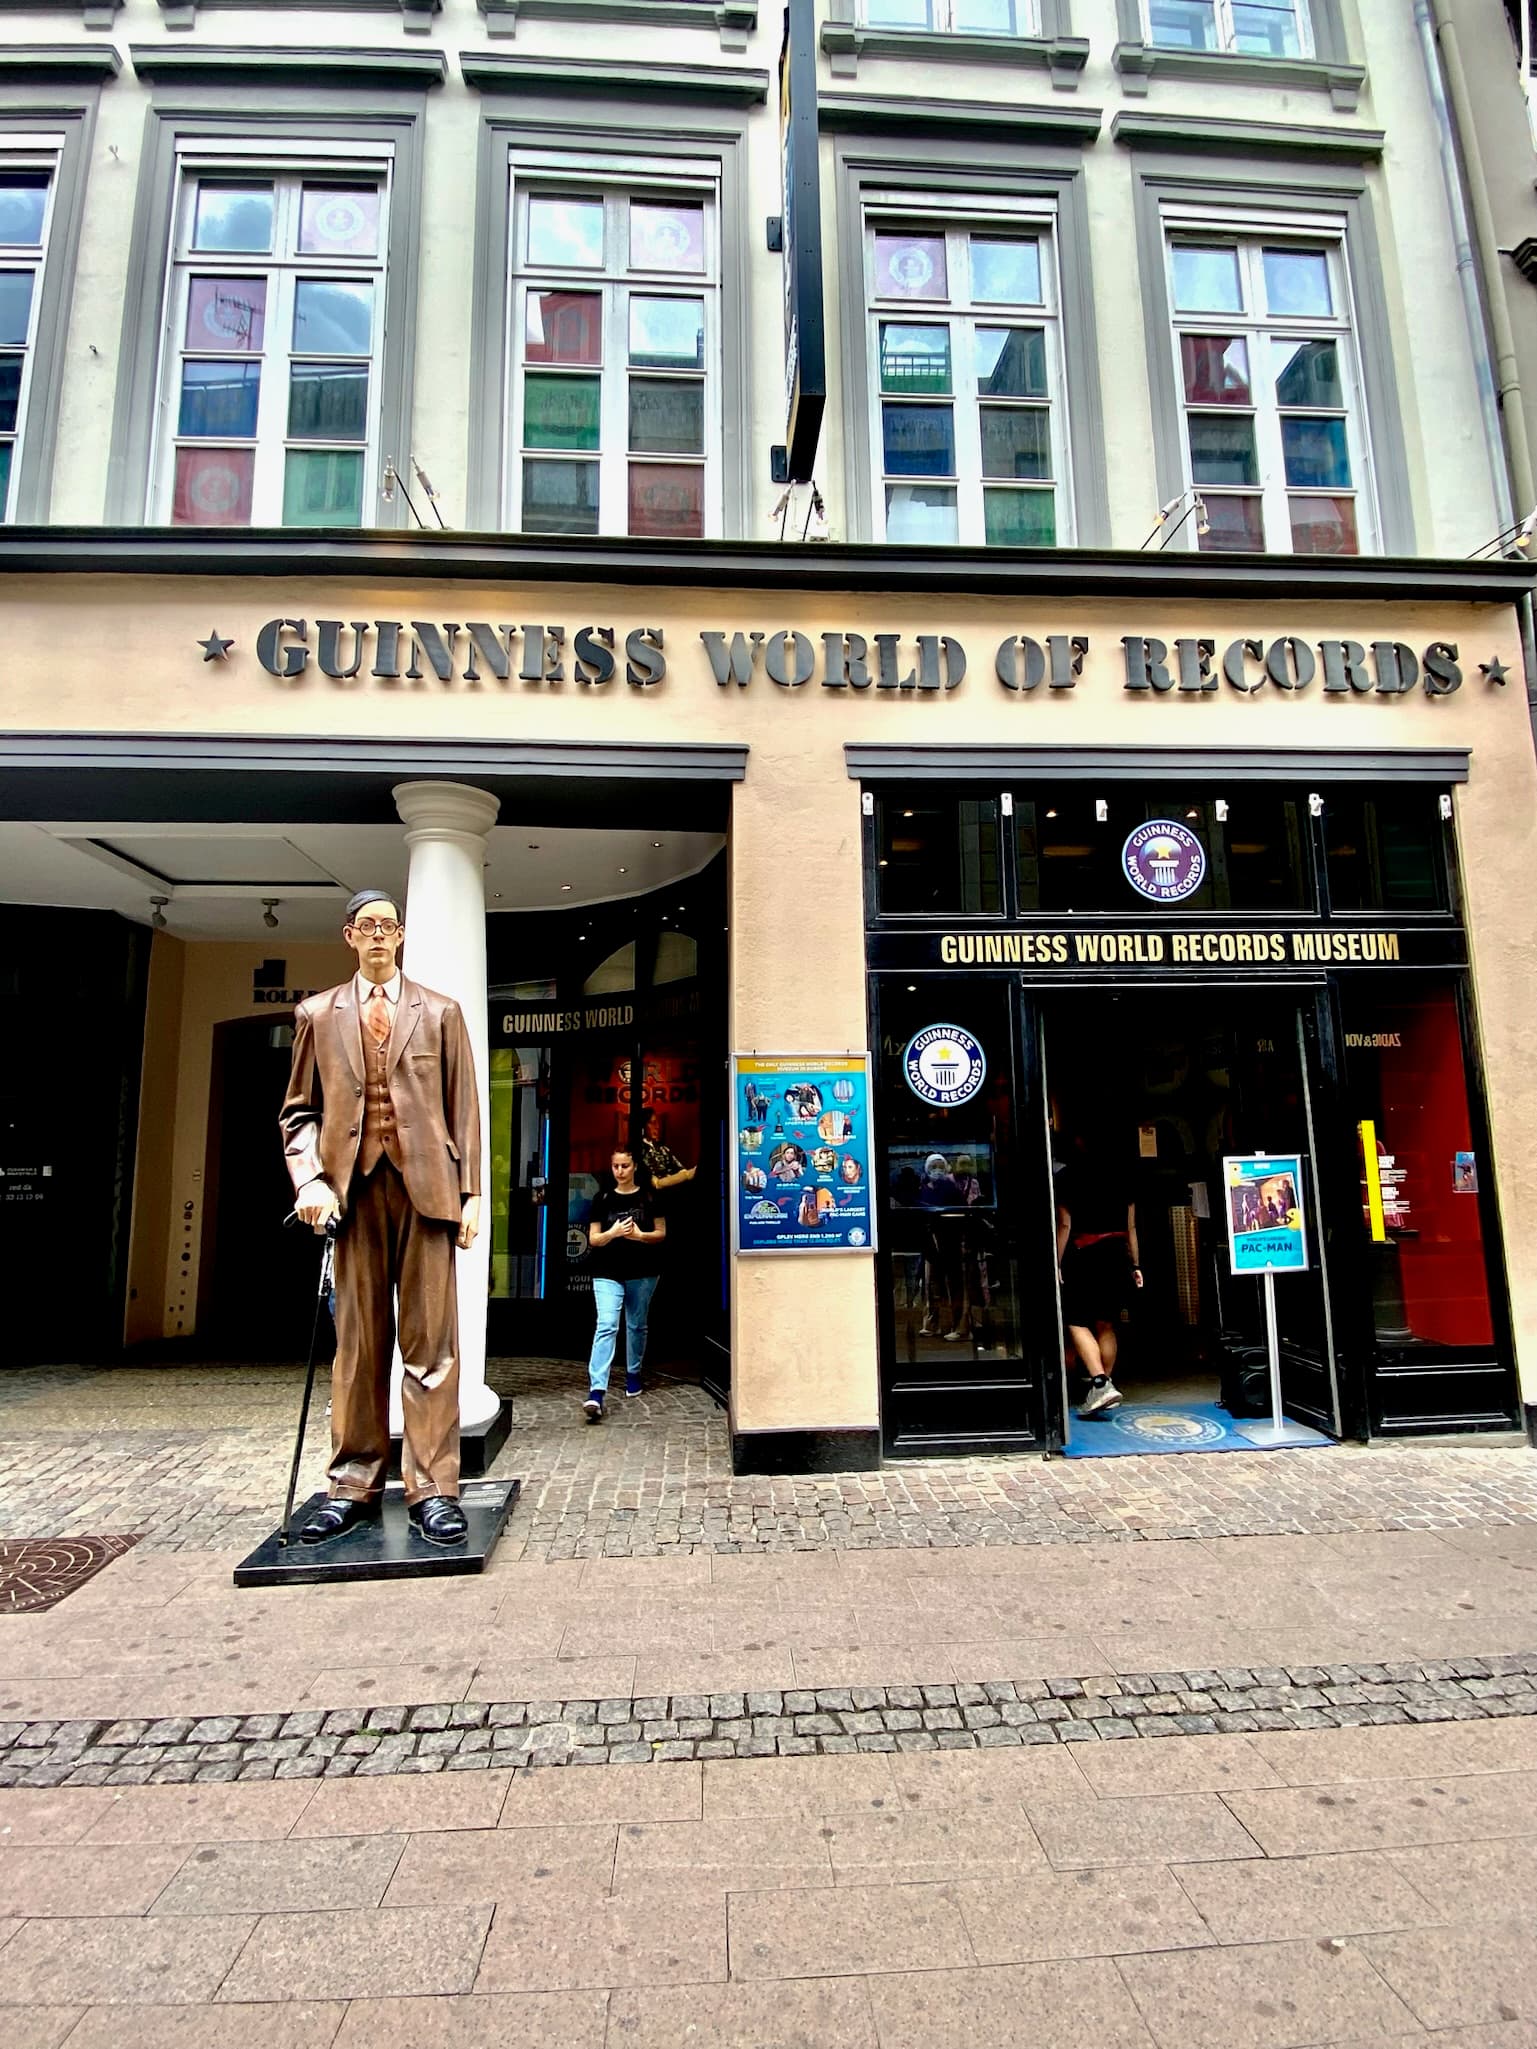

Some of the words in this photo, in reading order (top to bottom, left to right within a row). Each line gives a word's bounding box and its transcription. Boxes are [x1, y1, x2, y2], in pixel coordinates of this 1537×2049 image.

[256, 618, 667, 685] GUINNESS
[700, 630, 967, 690] WORLD
[995, 635, 1089, 690] OF
[1120, 636, 1463, 695] RECORDS
[1132, 825, 1194, 847] GUINNESS
[1127, 855, 1157, 894] WORLD
[1161, 855, 1201, 897] RECORDS
[941, 934, 1068, 963] GUINNESS
[1075, 934, 1164, 962] WORLD
[1172, 933, 1286, 962] RECORDS
[1293, 933, 1400, 961] MUSEUM
[502, 1011, 581, 1034] GUINNESS
[586, 1005, 635, 1029] WORLD
[914, 1028, 974, 1051] GUINNESS
[908, 1060, 938, 1099] WORLD
[941, 1059, 982, 1102] RECORDS
[1241, 1242, 1293, 1253] PAC-MAN
